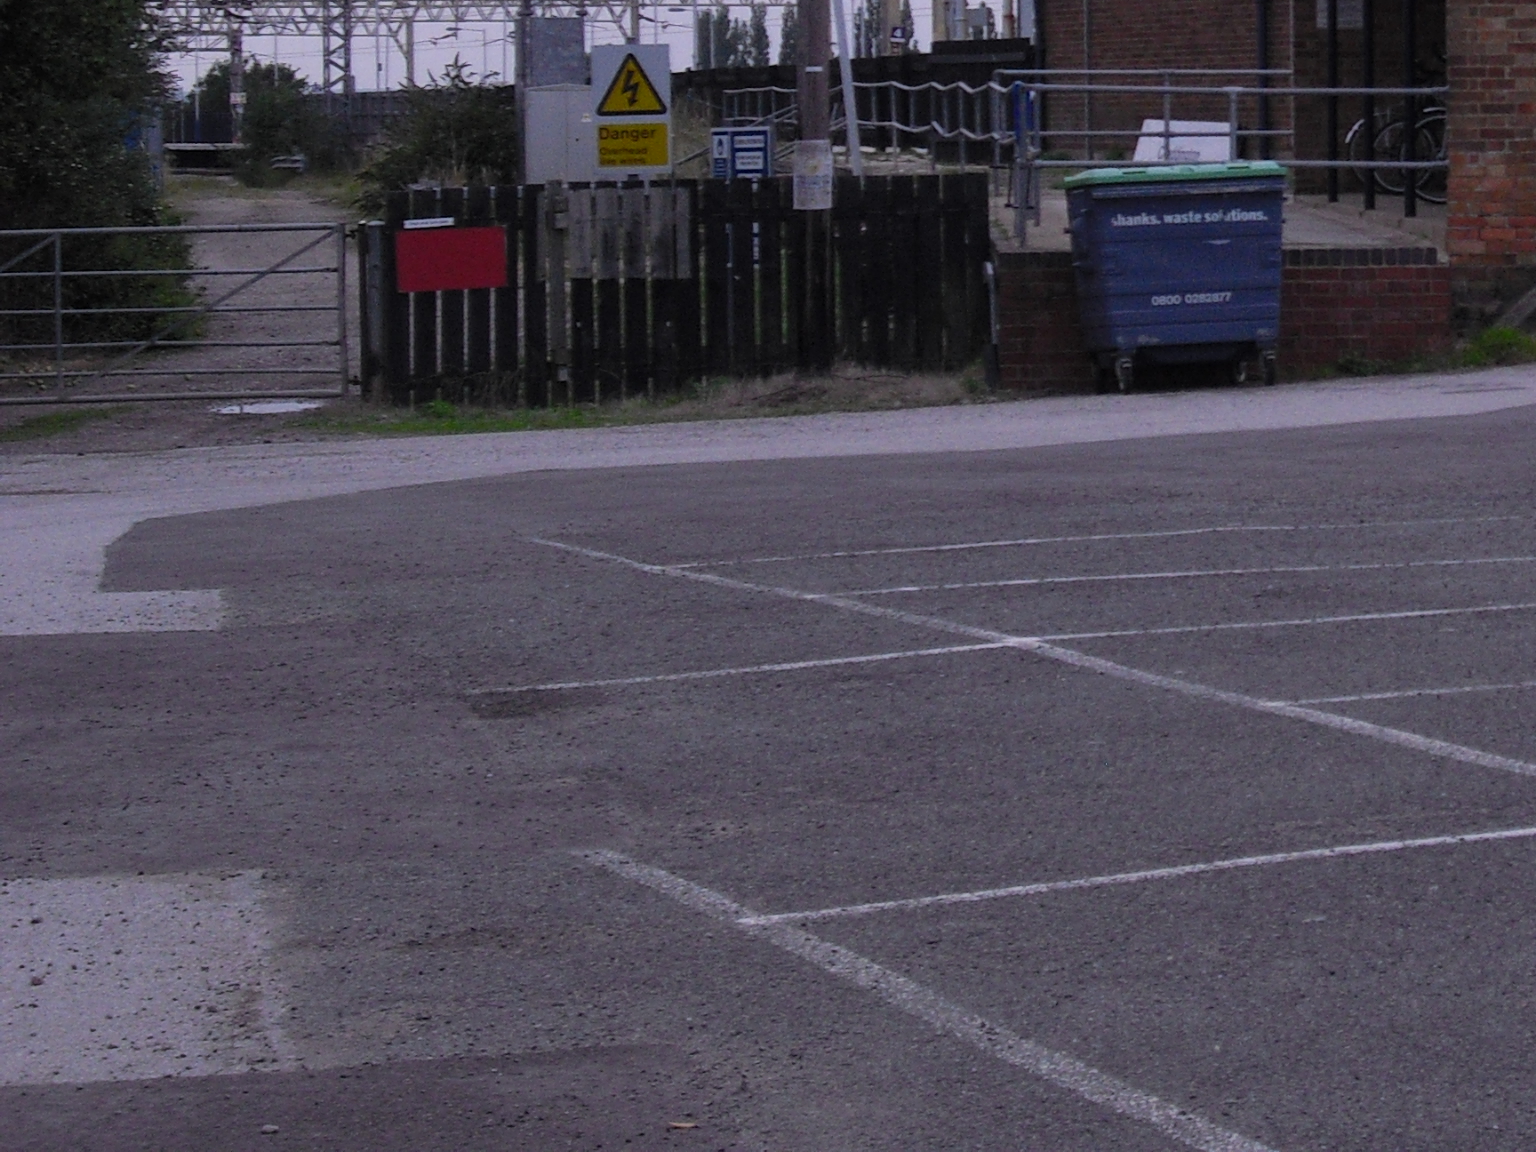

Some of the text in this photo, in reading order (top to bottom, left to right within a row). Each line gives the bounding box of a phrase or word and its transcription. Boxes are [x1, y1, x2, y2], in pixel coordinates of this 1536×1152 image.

[599, 127, 657, 142] Danger
[1163, 210, 1202, 224] waste
[1151, 295, 1182, 306] 0800
